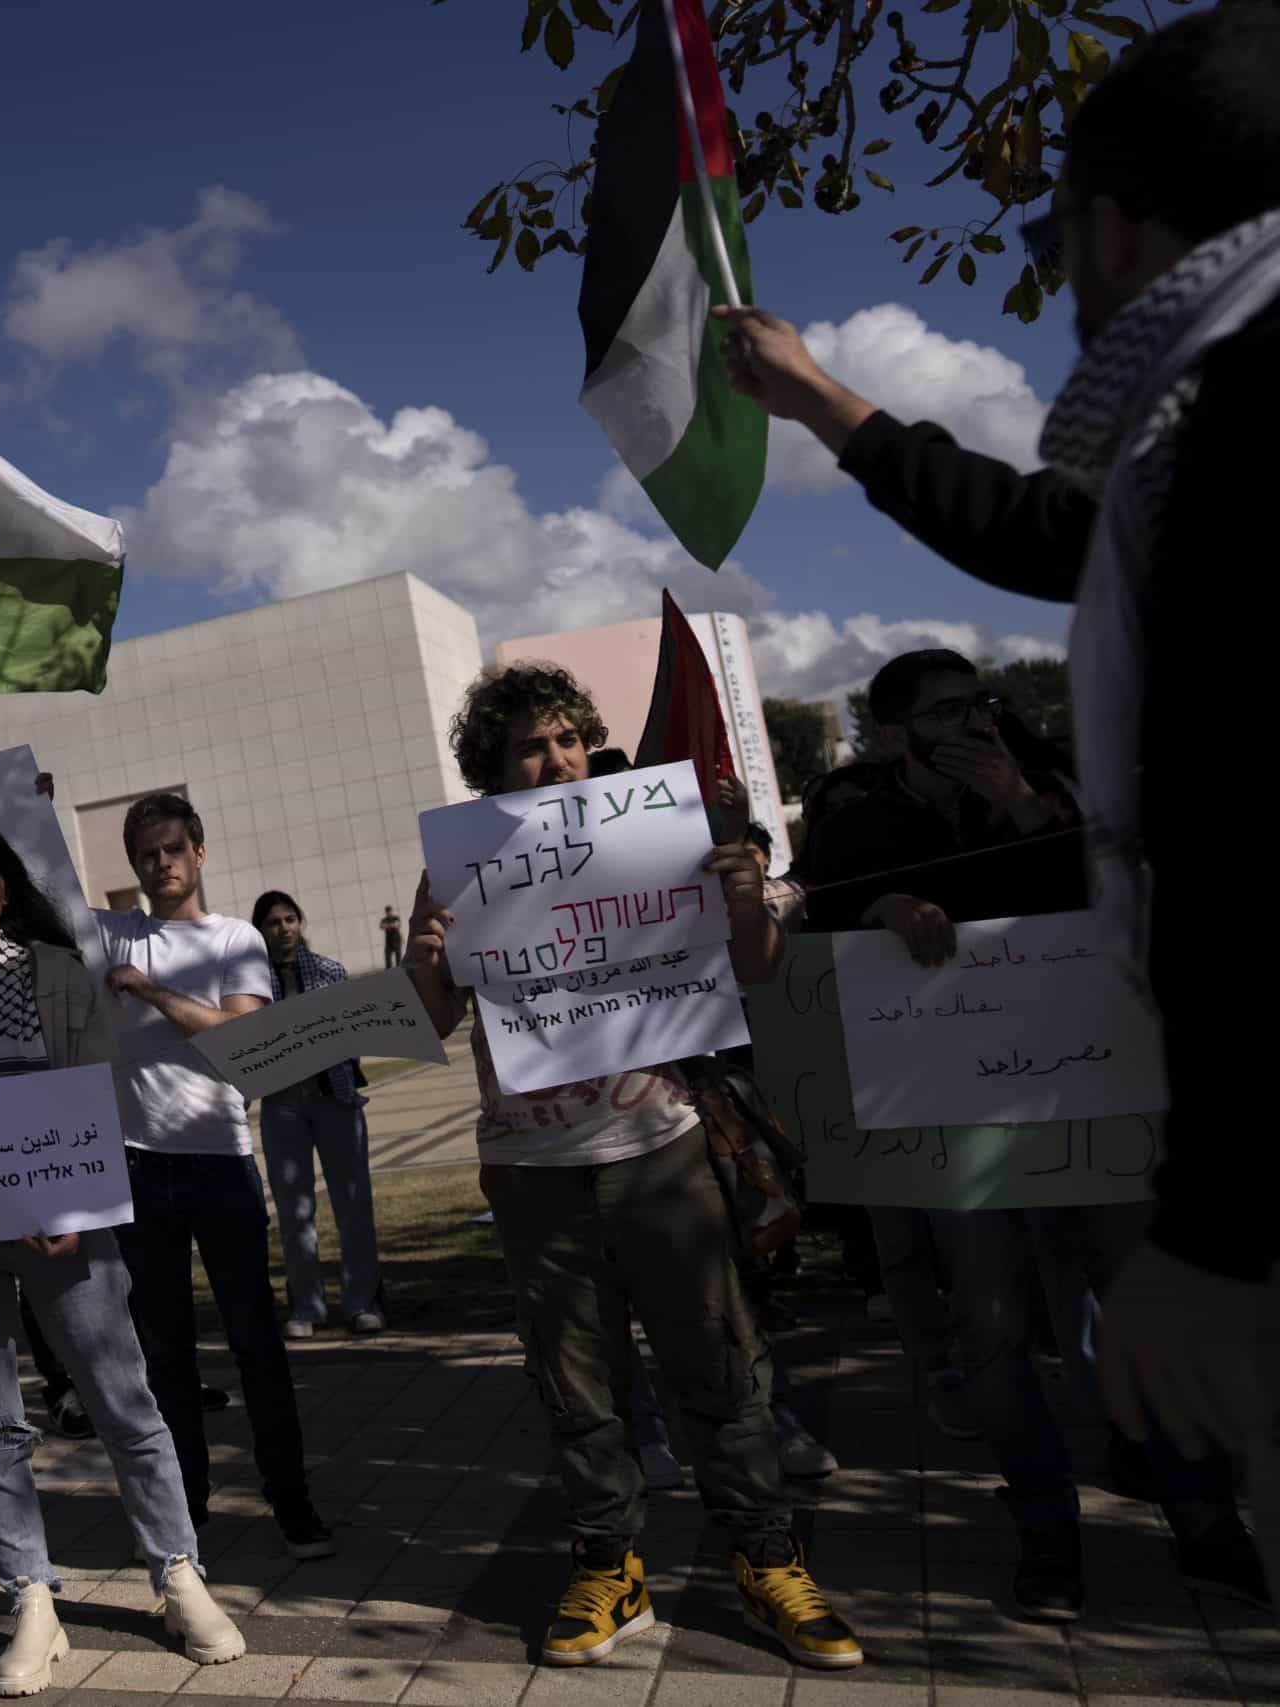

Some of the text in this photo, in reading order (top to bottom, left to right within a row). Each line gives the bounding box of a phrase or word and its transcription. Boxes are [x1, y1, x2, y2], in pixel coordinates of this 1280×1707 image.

[537, 778, 678, 831] מעזה
[552, 884, 704, 934] תשוחרר
[469, 928, 607, 985] פלסטין
[512, 948, 691, 1004] عبد الله مروان الغول
[567, 996, 620, 1025] מרואן
[21, 1128, 61, 1155] الدين
[71, 1123, 98, 1148] نور
[27, 1163, 73, 1189] אלדין
[79, 1159, 105, 1177] נור
